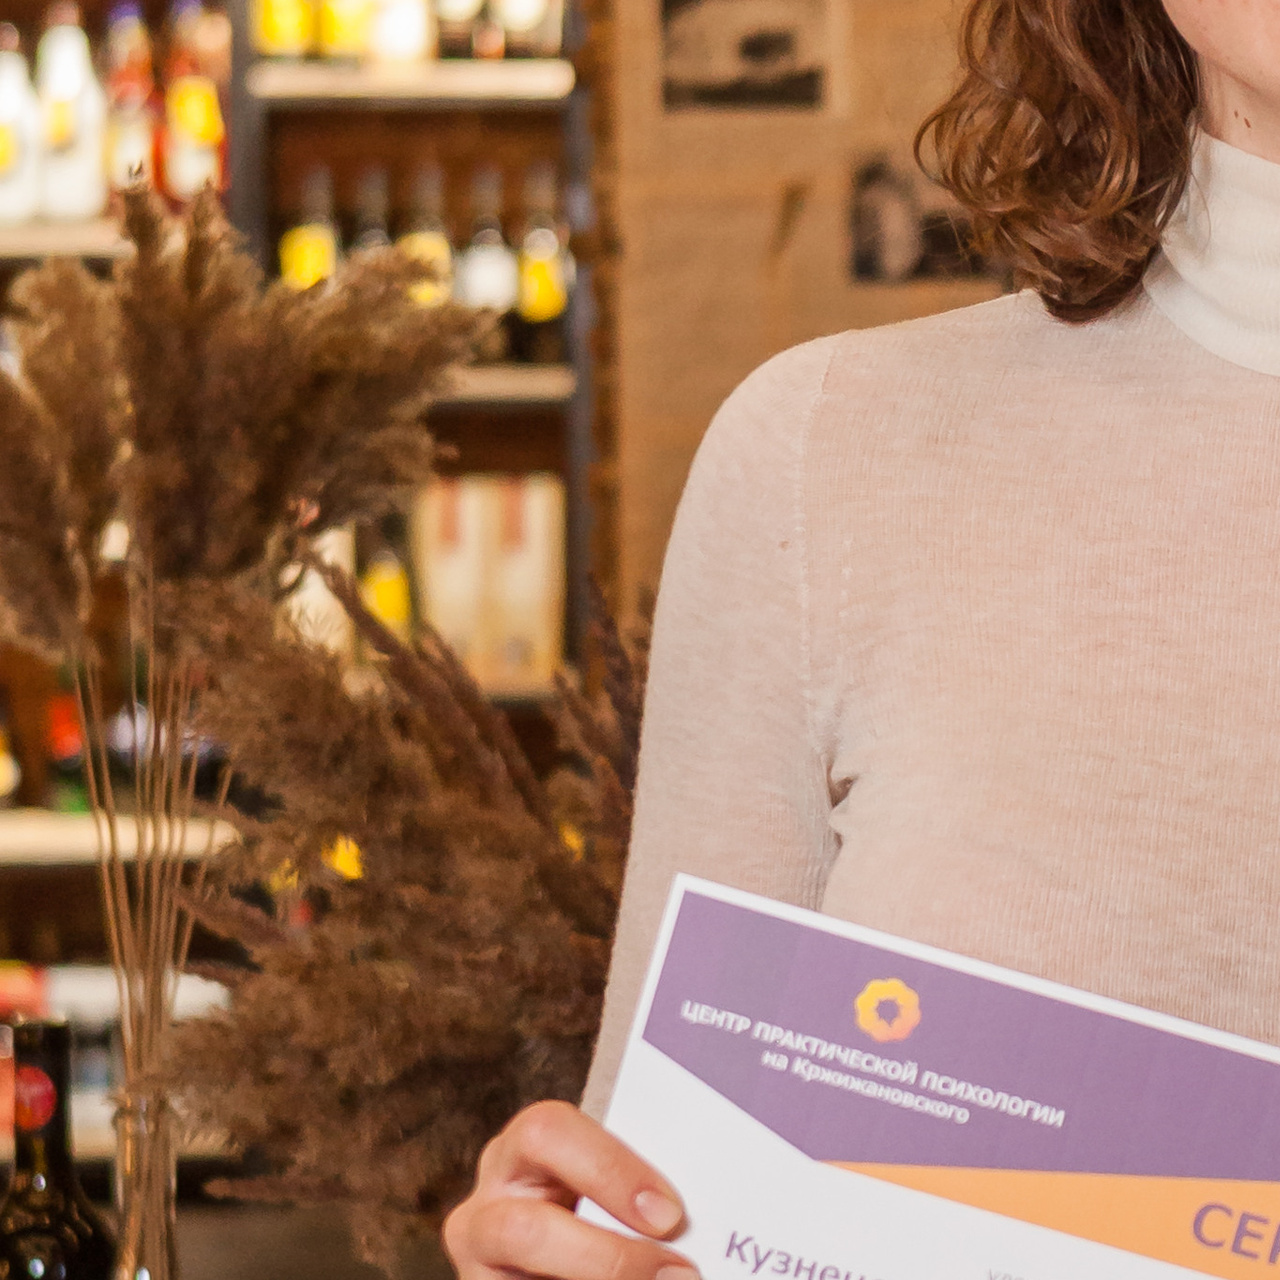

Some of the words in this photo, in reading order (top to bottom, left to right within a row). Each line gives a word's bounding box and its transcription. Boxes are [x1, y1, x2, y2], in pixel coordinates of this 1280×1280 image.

[680, 1000, 752, 1034] ЦЕНТР
[752, 1021, 918, 1085] ПРАКТИЧЕСКОЙ
[920, 1070, 1066, 1128] ПСИХОЛОГИИ
[761, 1050, 789, 1071] на
[791, 1056, 970, 1124] Кржижановского
